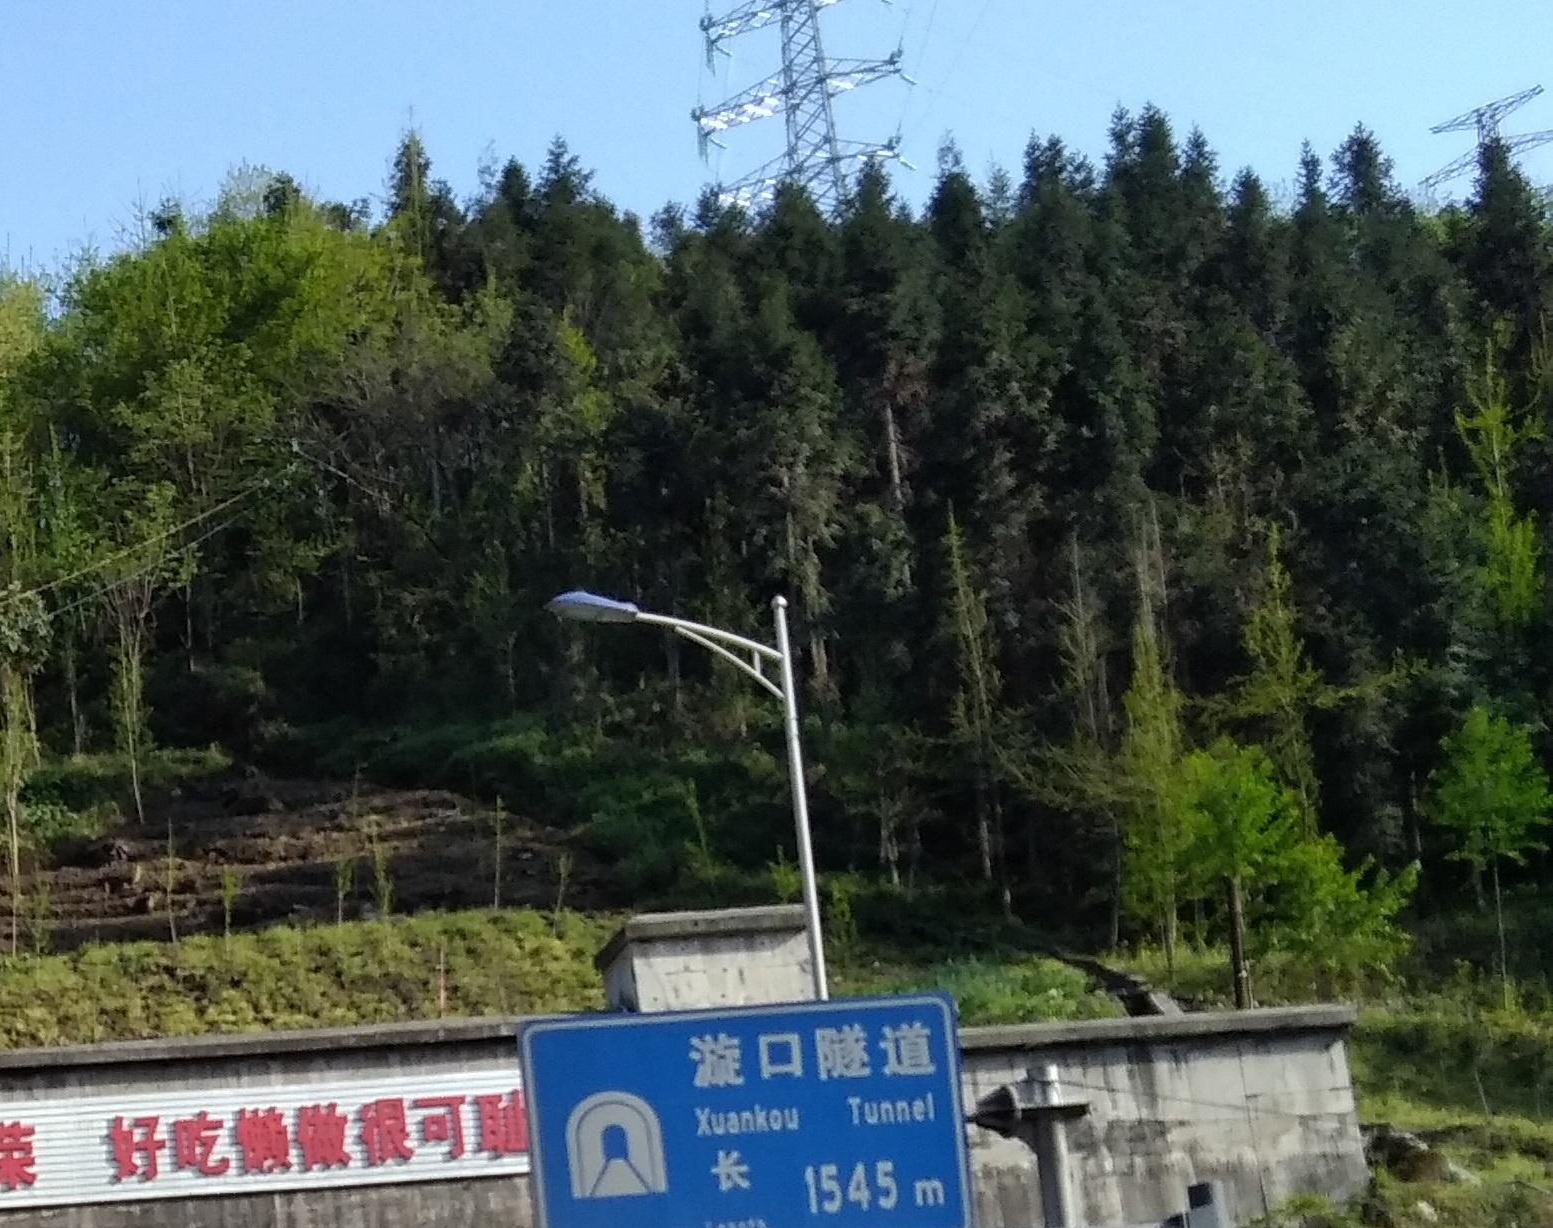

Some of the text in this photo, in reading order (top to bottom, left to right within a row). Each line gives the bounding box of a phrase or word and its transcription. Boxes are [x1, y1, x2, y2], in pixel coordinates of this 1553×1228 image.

[690, 1022, 936, 1088] 漩口隧道
[695, 1093, 935, 1137] Xuankou Tunnel
[711, 1149, 944, 1215] 长 1545 m
